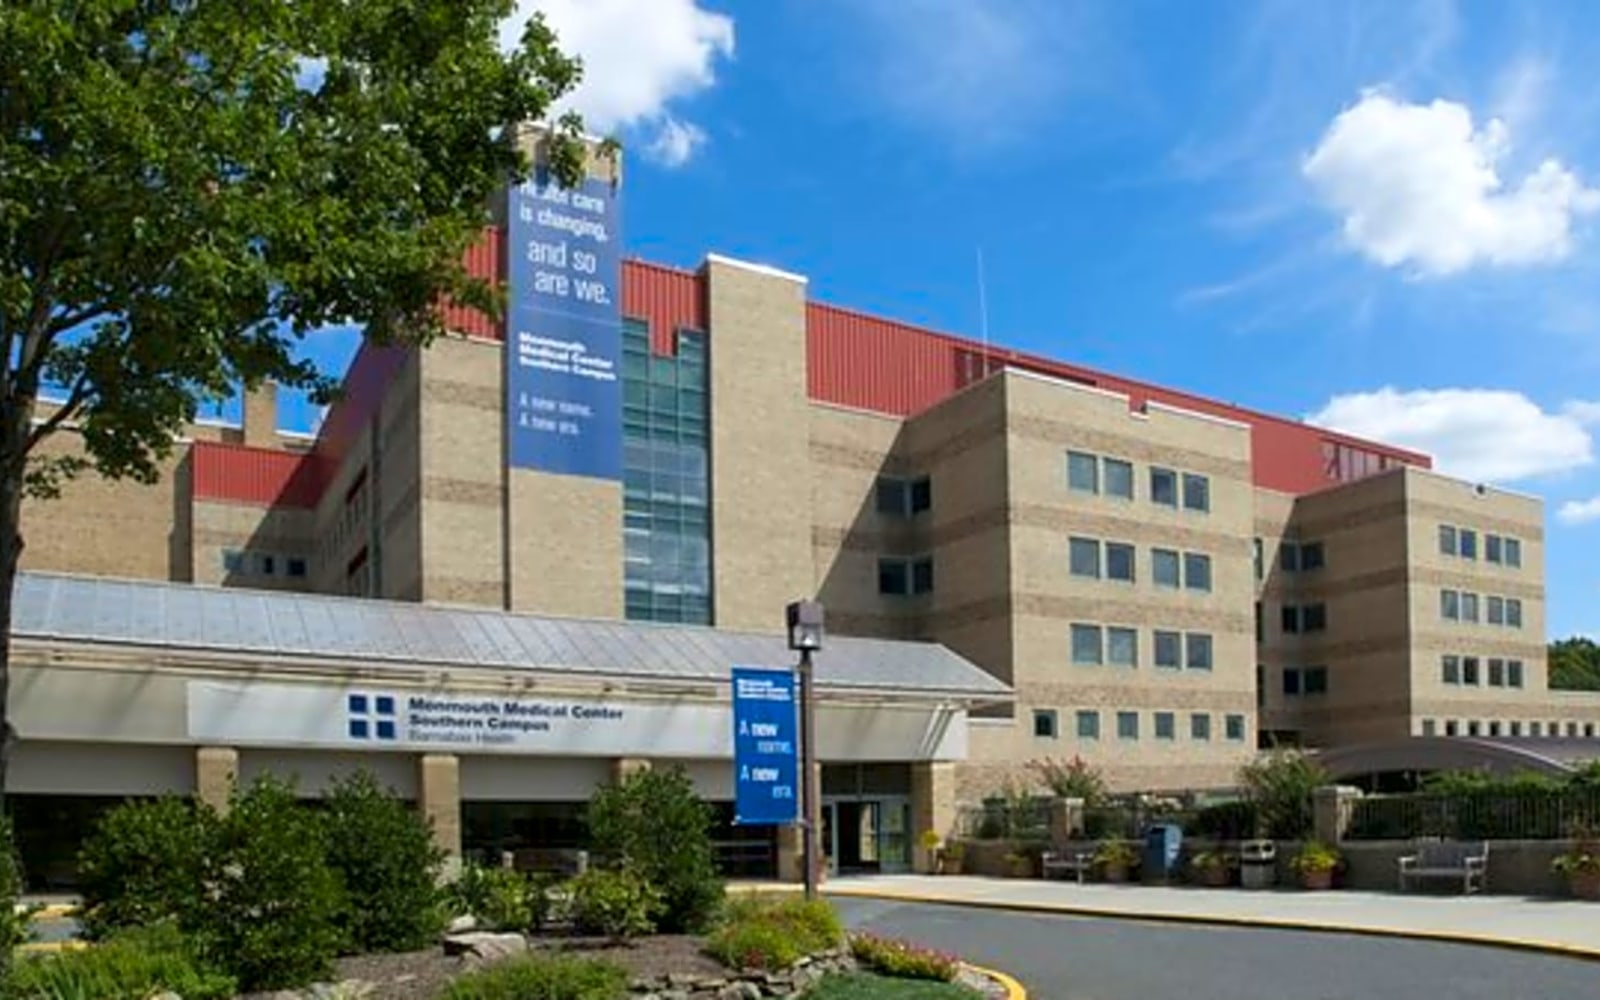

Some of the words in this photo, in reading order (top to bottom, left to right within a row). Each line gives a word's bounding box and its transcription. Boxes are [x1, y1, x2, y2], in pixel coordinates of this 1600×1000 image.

[520, 202, 533, 222] is
[528, 240, 567, 267] and
[573, 250, 597, 275] so
[535, 270, 569, 296] are
[573, 278, 611, 304] we.
[519, 391, 528, 407] A
[519, 411, 528, 427] A
[409, 697, 500, 714] Monmouth
[503, 701, 567, 717] Medical
[571, 705, 623, 719] Center
[409, 713, 483, 728] Southern
[487, 717, 549, 731] Campus
[739, 719, 749, 736] A
[751, 722, 779, 737] new
[740, 764, 750, 782] A
[752, 767, 780, 782] new
